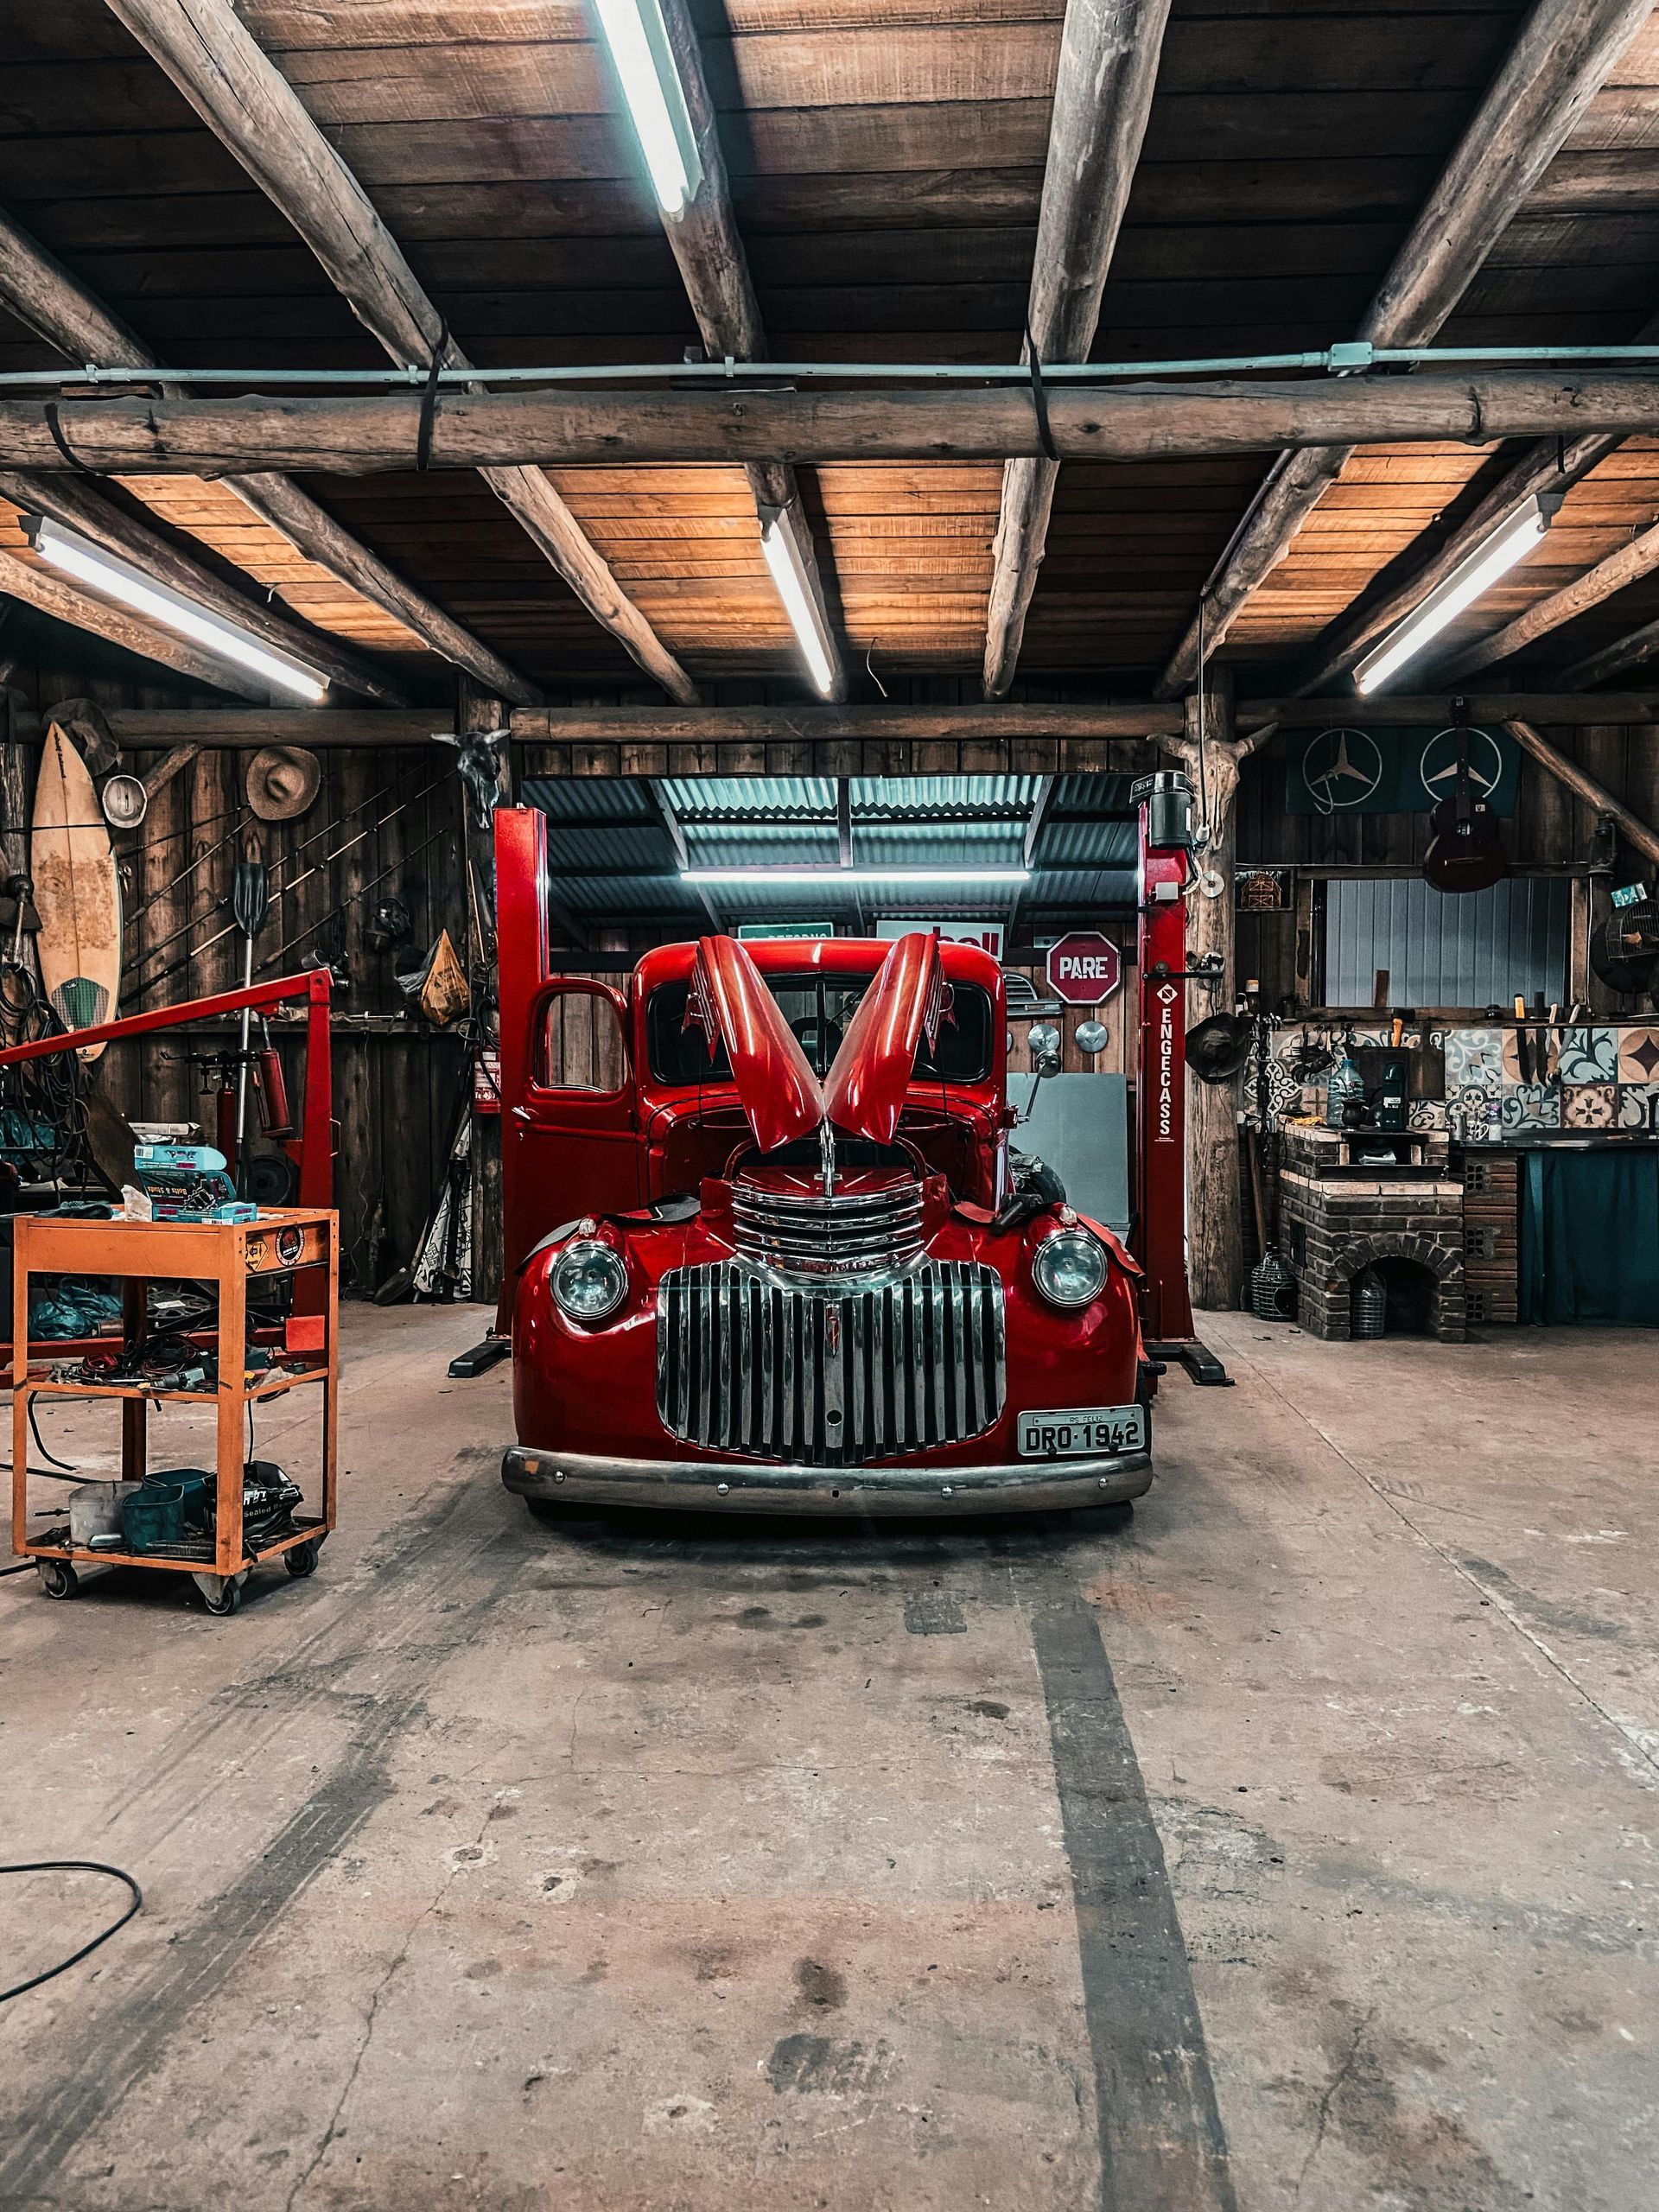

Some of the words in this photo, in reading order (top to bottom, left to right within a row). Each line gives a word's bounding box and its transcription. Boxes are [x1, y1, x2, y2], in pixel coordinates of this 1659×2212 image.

[1059, 957, 1109, 979] PARE
[1159, 1008, 1173, 1135] ENGECASS
[244, 1507, 271, 1517] Sealed
